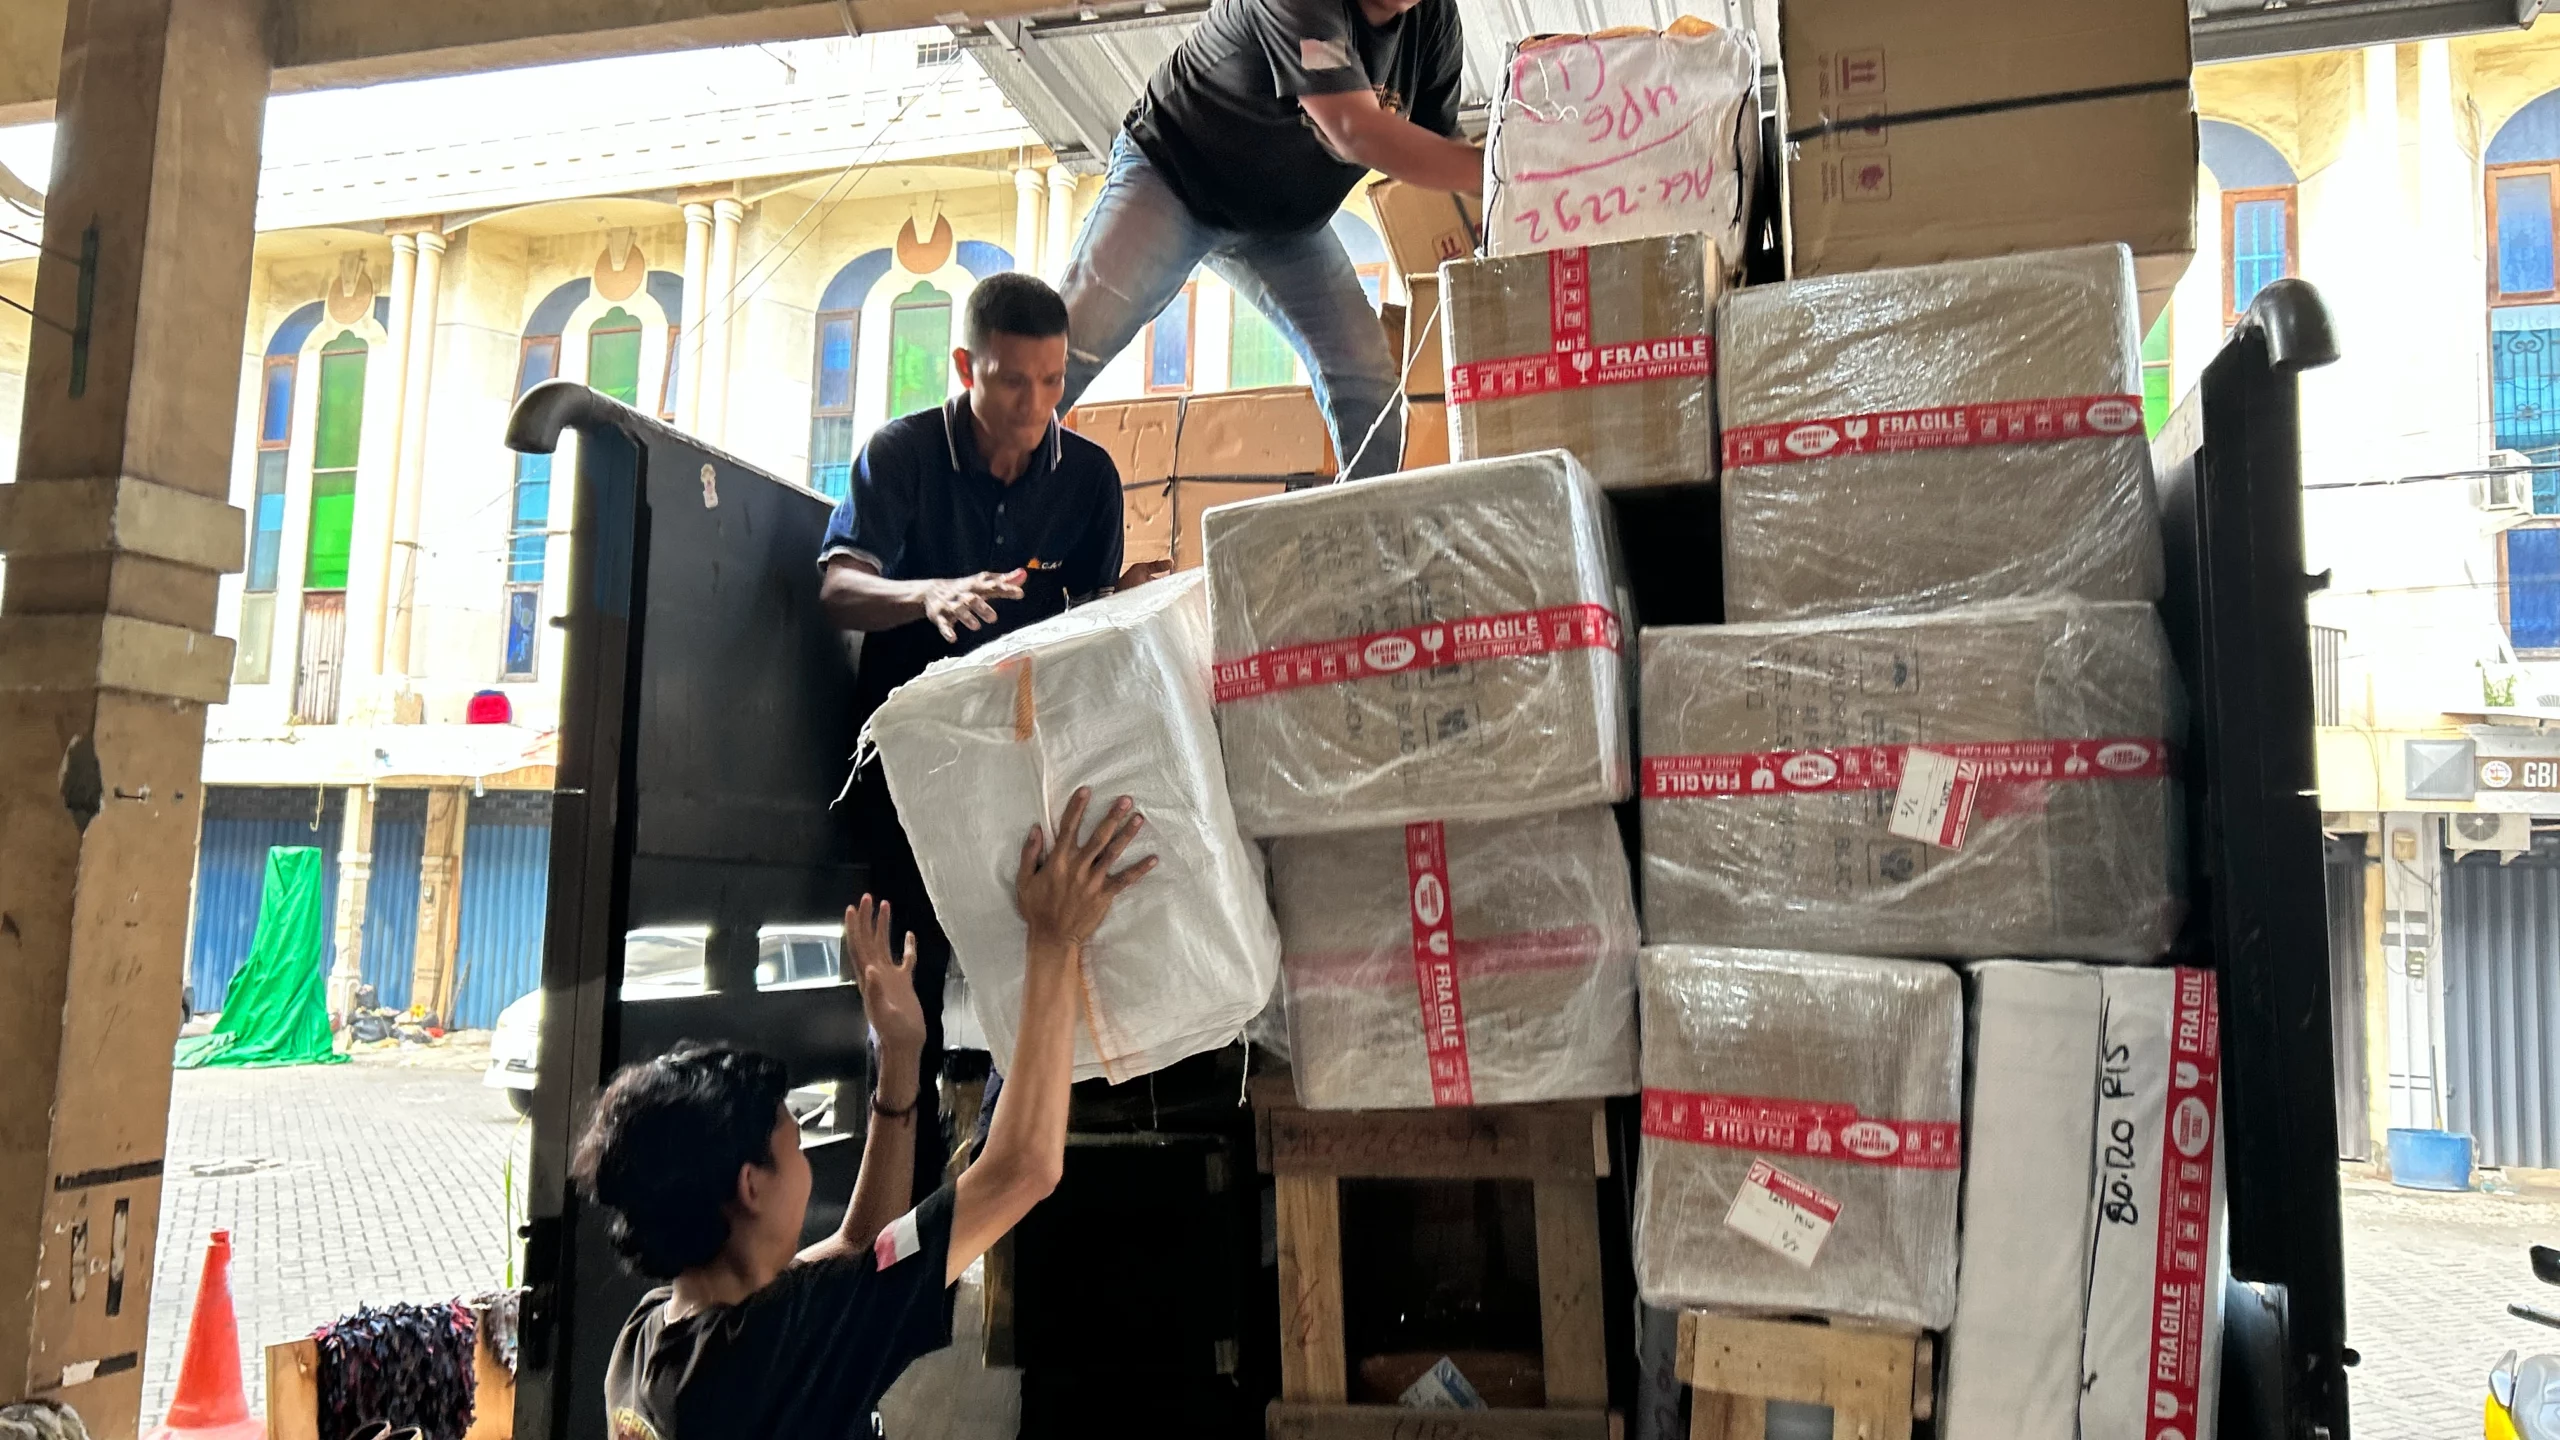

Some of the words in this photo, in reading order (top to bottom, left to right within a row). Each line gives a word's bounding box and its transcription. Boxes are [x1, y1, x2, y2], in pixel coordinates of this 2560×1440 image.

[1600, 338, 1707, 367] FRAGILE
[1597, 366, 1644, 382] HANDLE
[1649, 363, 1677, 378] WITH
[1878, 410, 1967, 434] FRAGILE
[1452, 615, 1539, 645] FRAGILE
[1212, 660, 1260, 685] AGILE
[1656, 772, 1740, 792] FRAGILE
[2523, 762, 2558, 788] GBI
[1434, 962, 1460, 1049] FRAGILE
[2178, 972, 2202, 1052] FRAGIL
[1702, 1118, 1795, 1149] FRAGILE
[2157, 1282, 2182, 1382] FRAGILE
